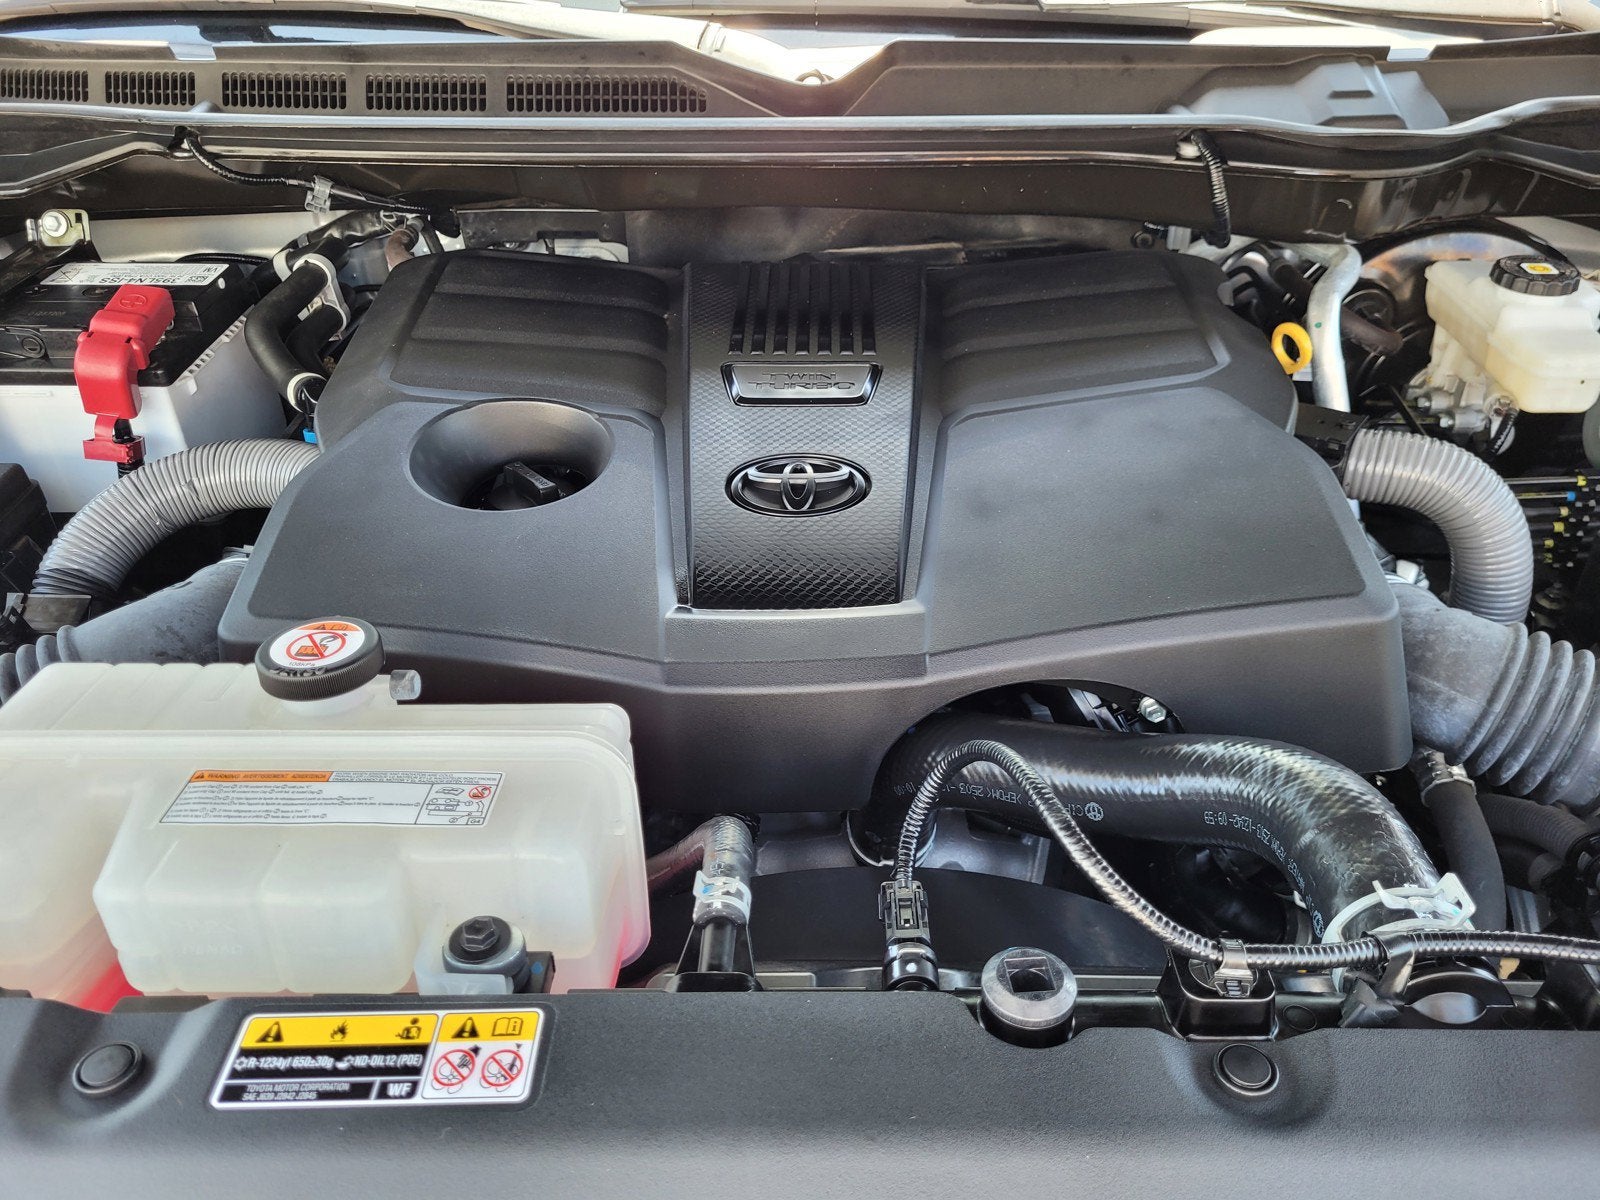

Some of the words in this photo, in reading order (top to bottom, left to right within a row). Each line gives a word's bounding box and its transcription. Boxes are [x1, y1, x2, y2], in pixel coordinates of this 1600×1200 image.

[748, 382, 856, 390] TURBO
[247, 1084, 273, 1092] TOYOTA
[274, 1084, 299, 1092] MOTOR
[300, 1083, 350, 1091] CORPORATION
[387, 1083, 412, 1097] WF
